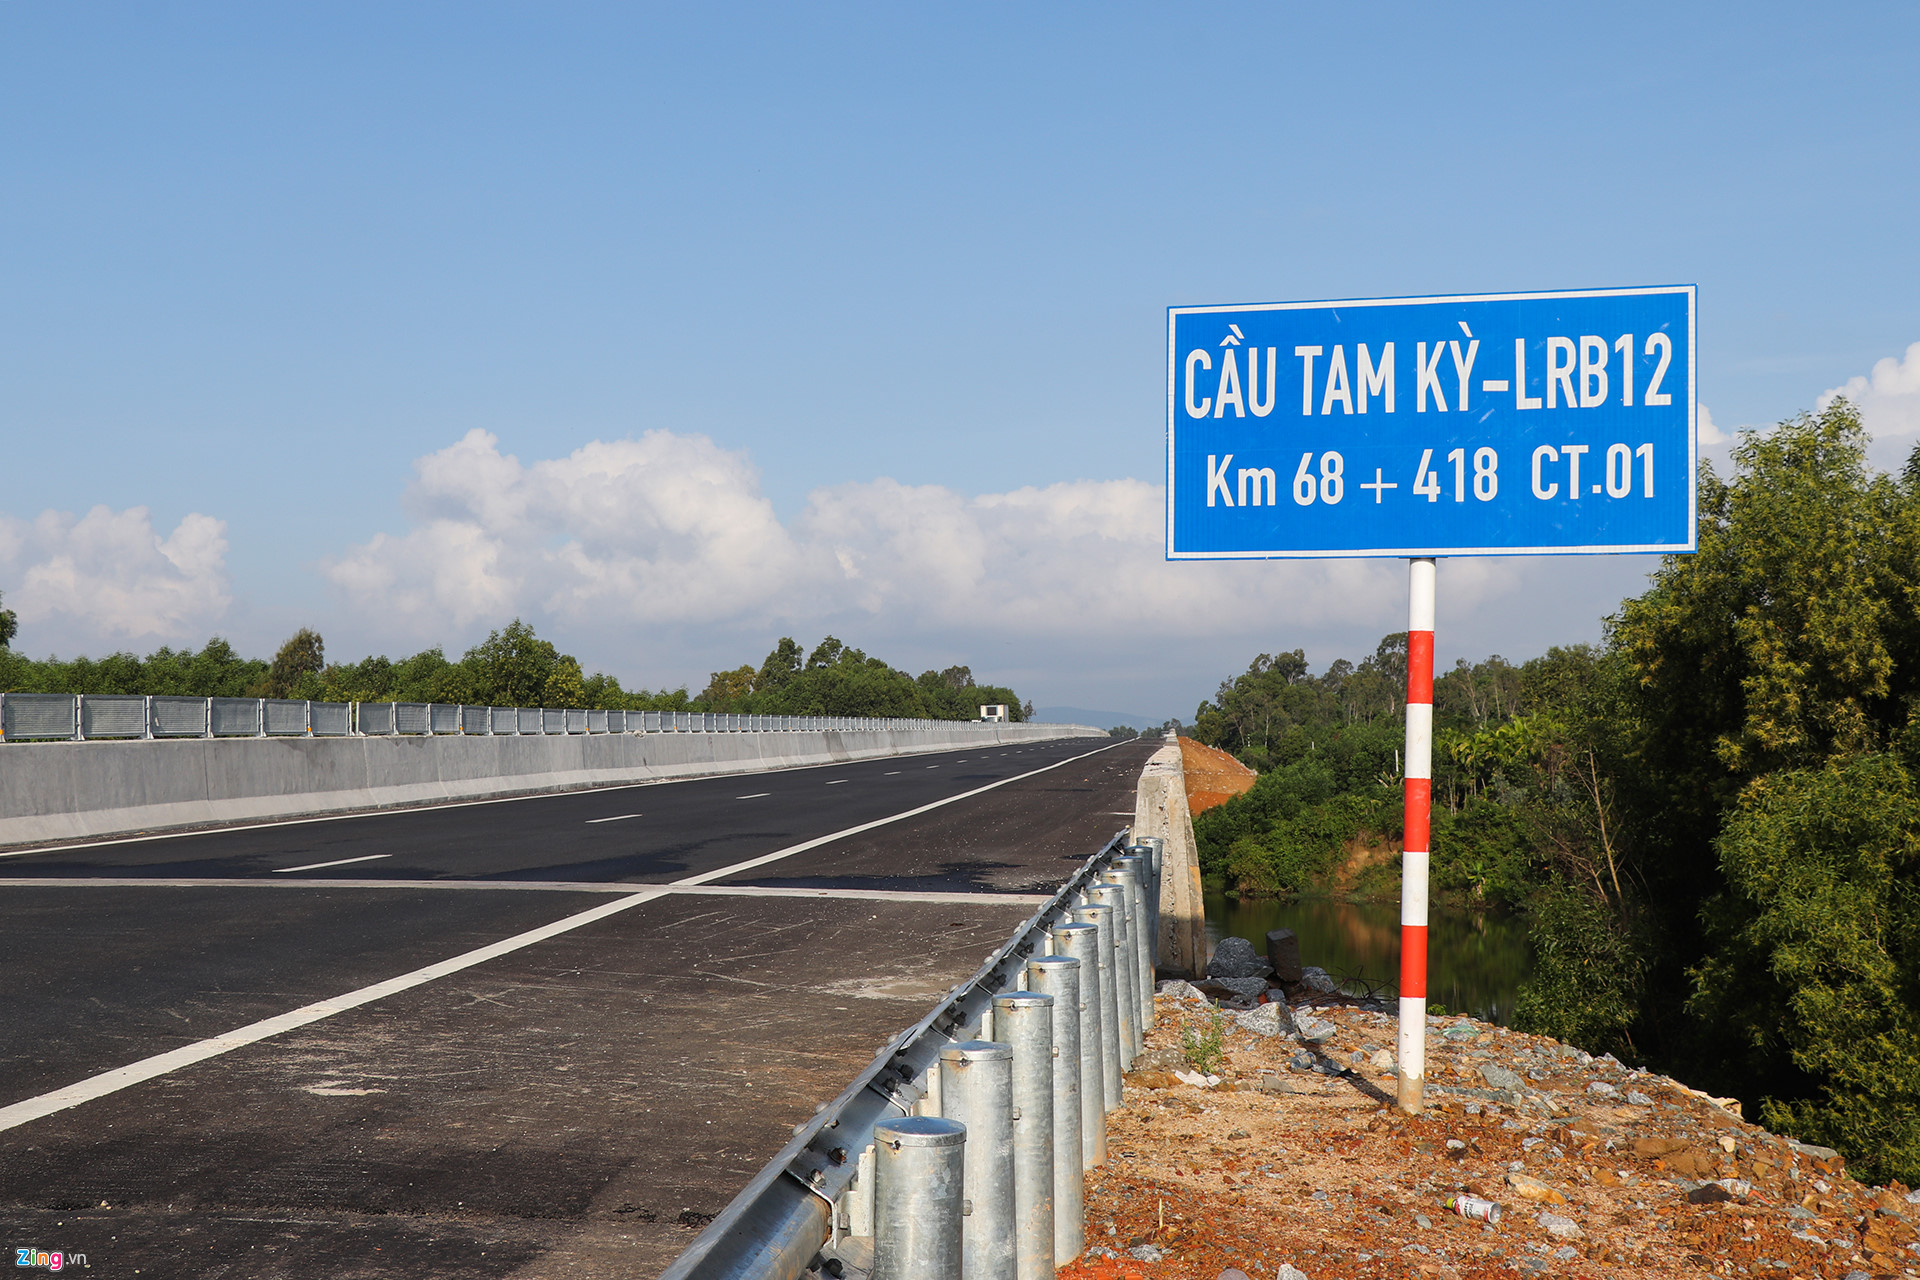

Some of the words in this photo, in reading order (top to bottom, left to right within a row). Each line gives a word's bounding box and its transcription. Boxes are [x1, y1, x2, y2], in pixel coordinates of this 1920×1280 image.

[1185, 324, 1276, 418] CẦU
[1295, 342, 1394, 415] TAM
[1207, 455, 1275, 507] Km
[1293, 451, 1343, 505] 68
[1360, 468, 1397, 503] +
[1413, 447, 1498, 502] 418
[1532, 443, 1653, 500] CT.01
